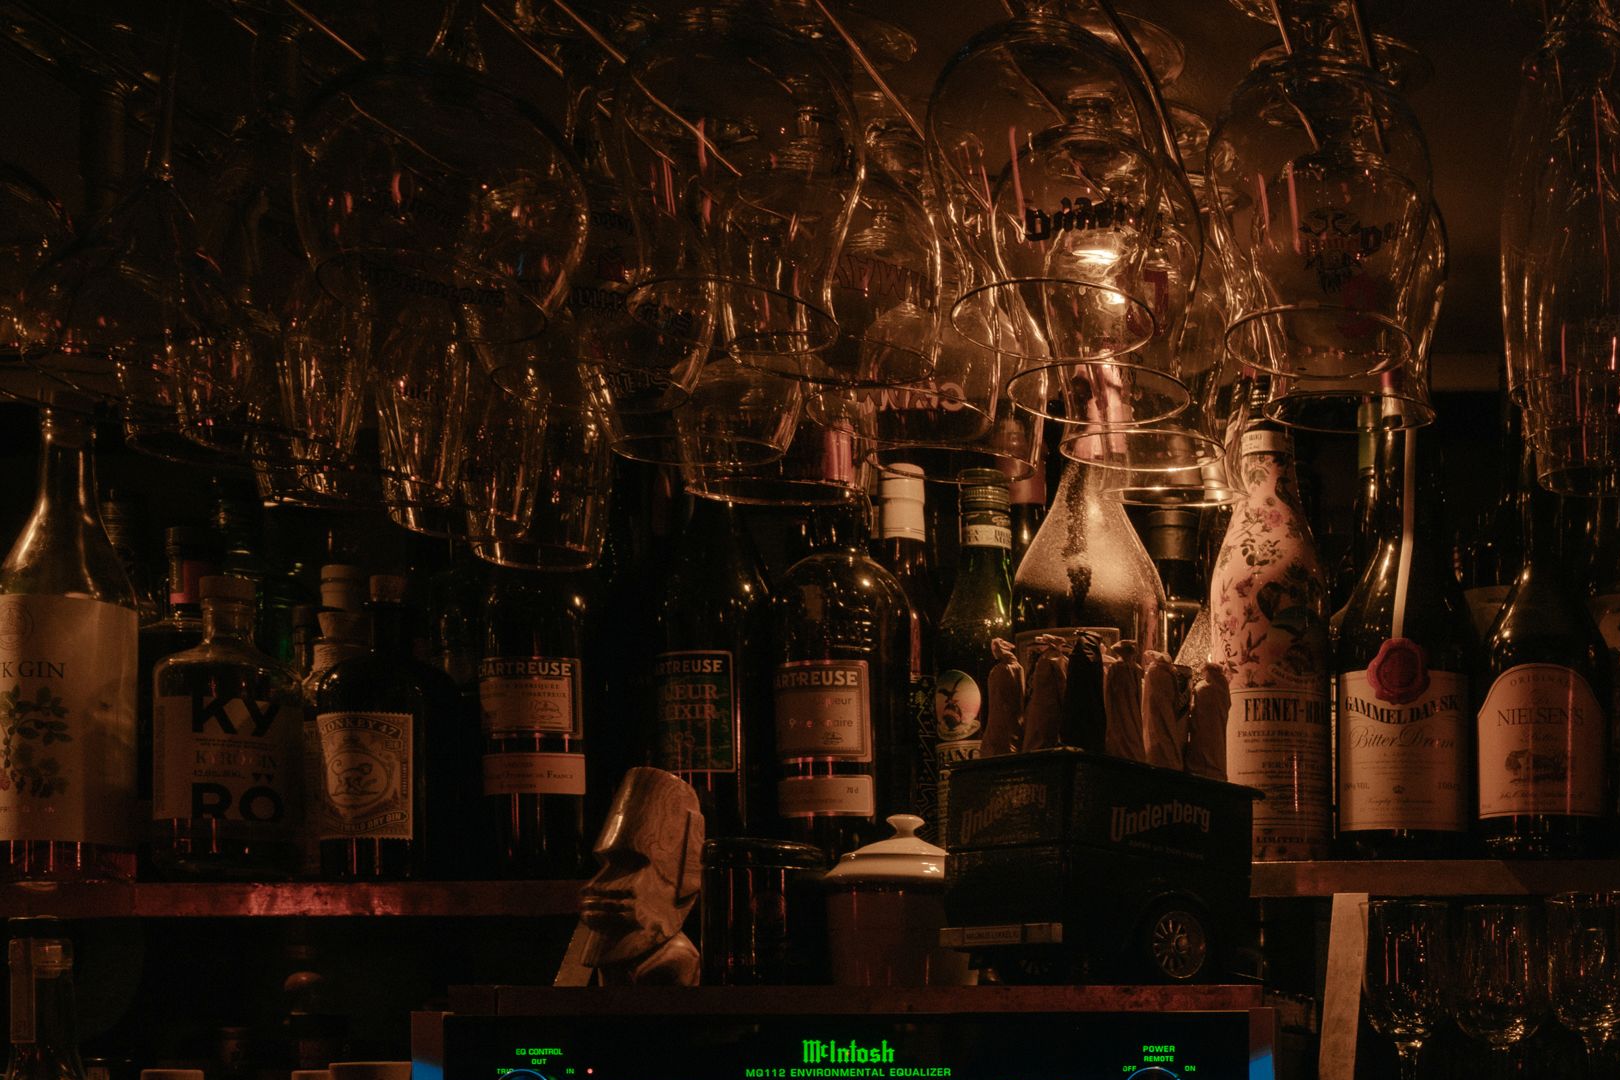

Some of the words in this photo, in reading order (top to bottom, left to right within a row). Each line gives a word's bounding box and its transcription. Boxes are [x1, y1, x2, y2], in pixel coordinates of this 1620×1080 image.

[18, 661, 66, 679] GIN
[478, 661, 572, 676] HARTREUSE
[656, 659, 724, 674] ARTREUSE
[775, 670, 858, 689] ARTREUSE
[1344, 697, 1407, 725] GAMMEL
[1497, 706, 1584, 727] NIELSEN'S
[1350, 725, 1399, 749] Bitter
[1108, 799, 1213, 844] Underberg
[515, 1048, 527, 1056] EQ
[528, 1048, 563, 1056] CONTROL
[802, 1039, 895, 1064] McIntosh
[1142, 1045, 1176, 1053] POWER
[745, 1068, 786, 1077] MQ112
[790, 1068, 885, 1077] ENVIRONMENTAL
[889, 1067, 952, 1077] EQUALIZER
